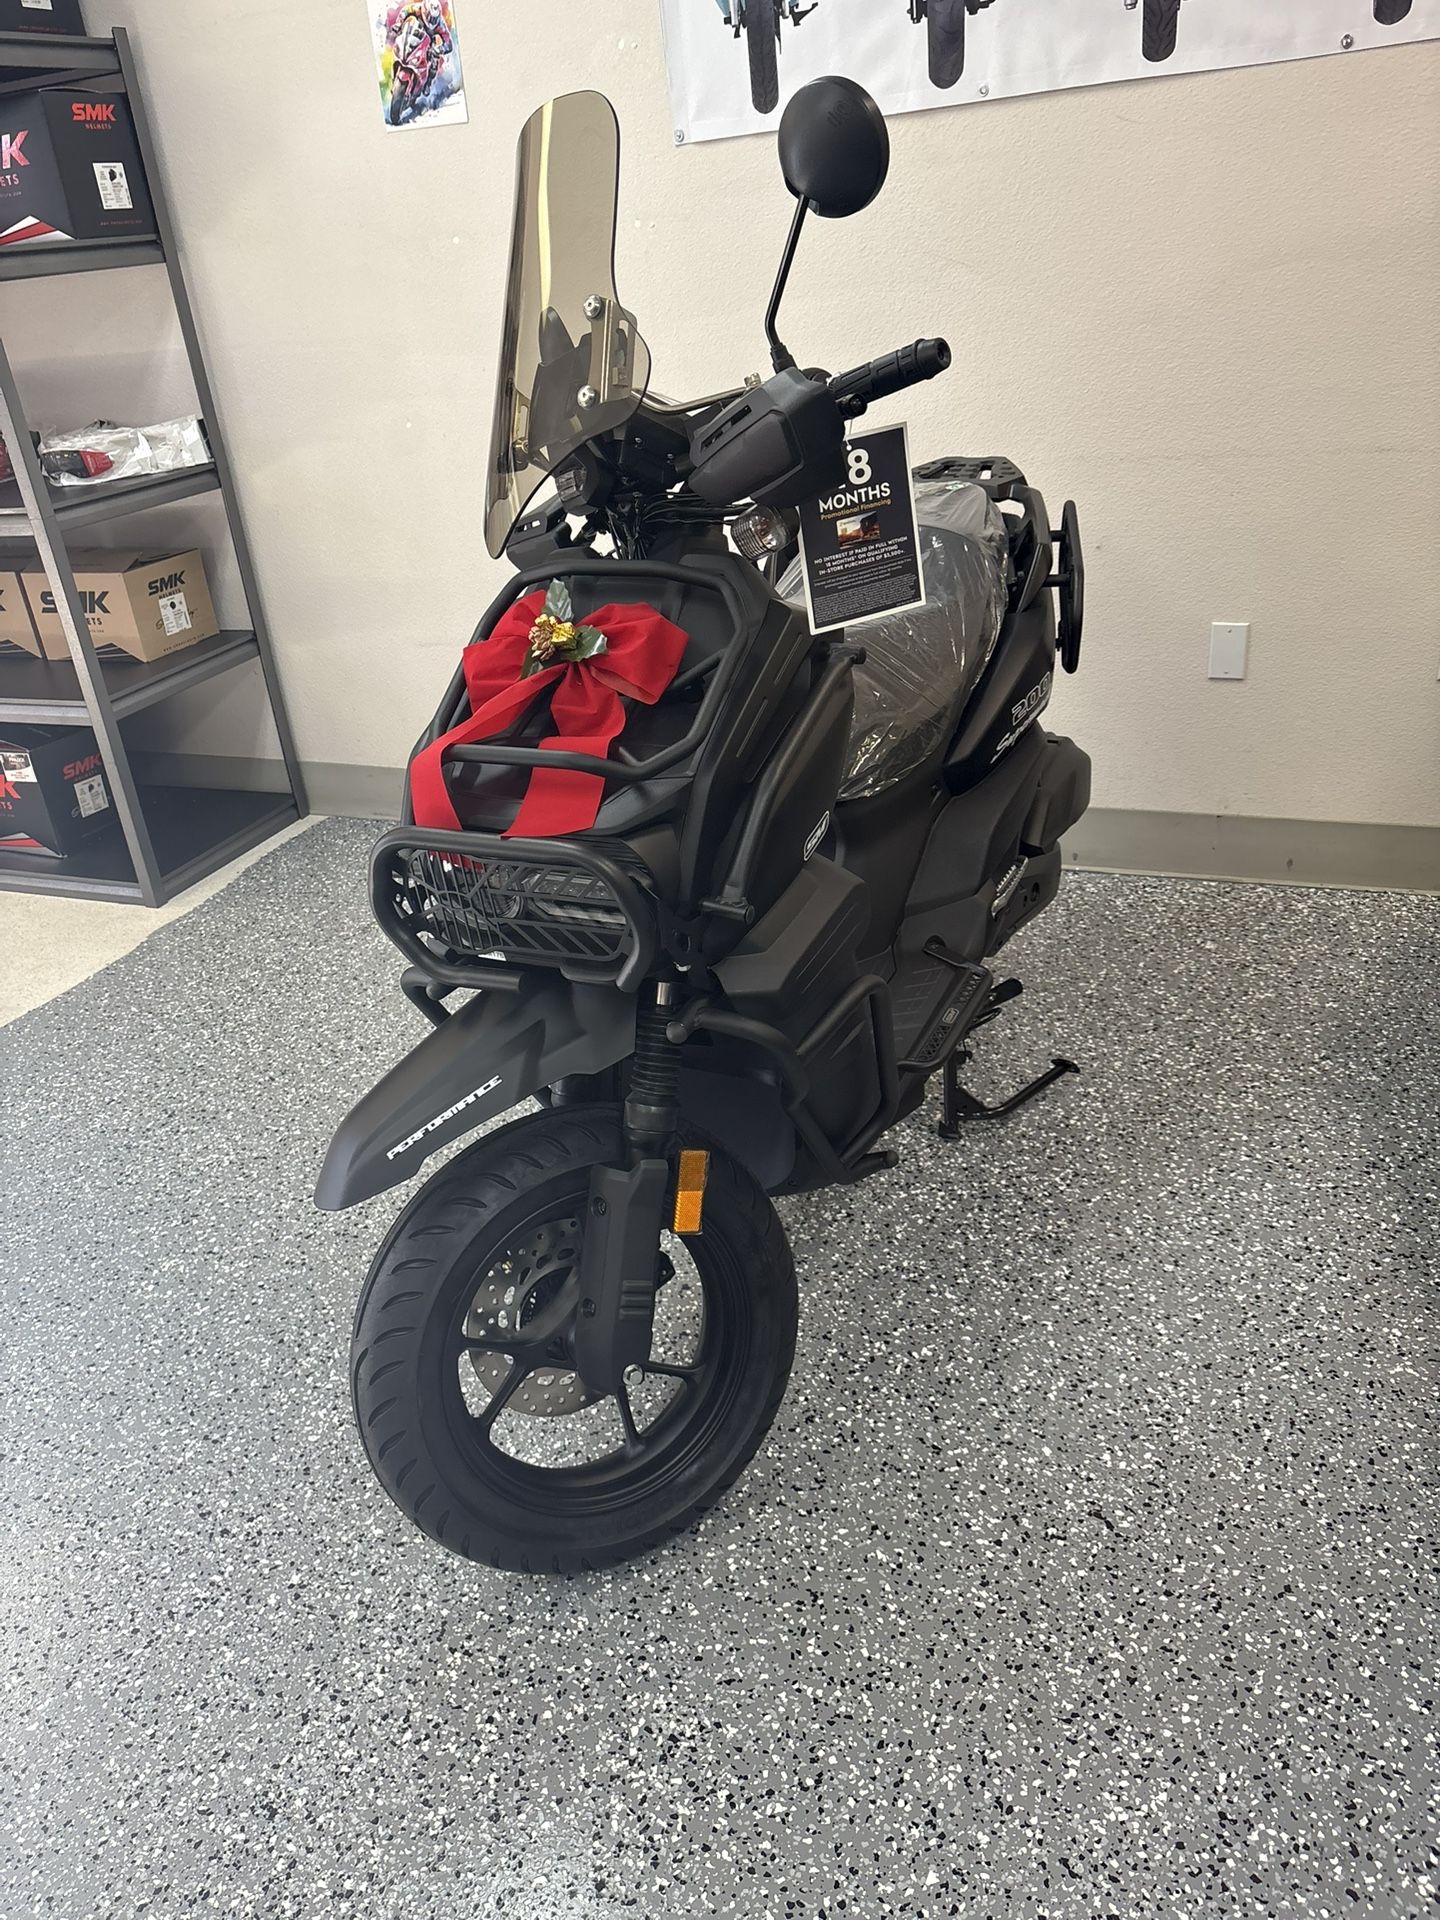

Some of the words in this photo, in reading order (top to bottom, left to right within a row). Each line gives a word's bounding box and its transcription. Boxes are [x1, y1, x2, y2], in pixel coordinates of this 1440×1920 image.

[71, 102, 117, 121] SMK
[838, 448, 872, 485] 8
[818, 482, 891, 513] MONTHS
[821, 505, 860, 520] Promotional
[860, 498, 892, 511] Financing
[823, 551, 848, 562] INTEREST
[875, 541, 887, 549] FULL
[867, 544, 899, 557] QUALIFYING
[819, 564, 844, 575] IN-STORE
[844, 556, 875, 569] PURCHASES
[147, 570, 186, 596] SMK
[63, 753, 102, 780] SMK
[386, 1075, 503, 1161] PERFORMANCE
